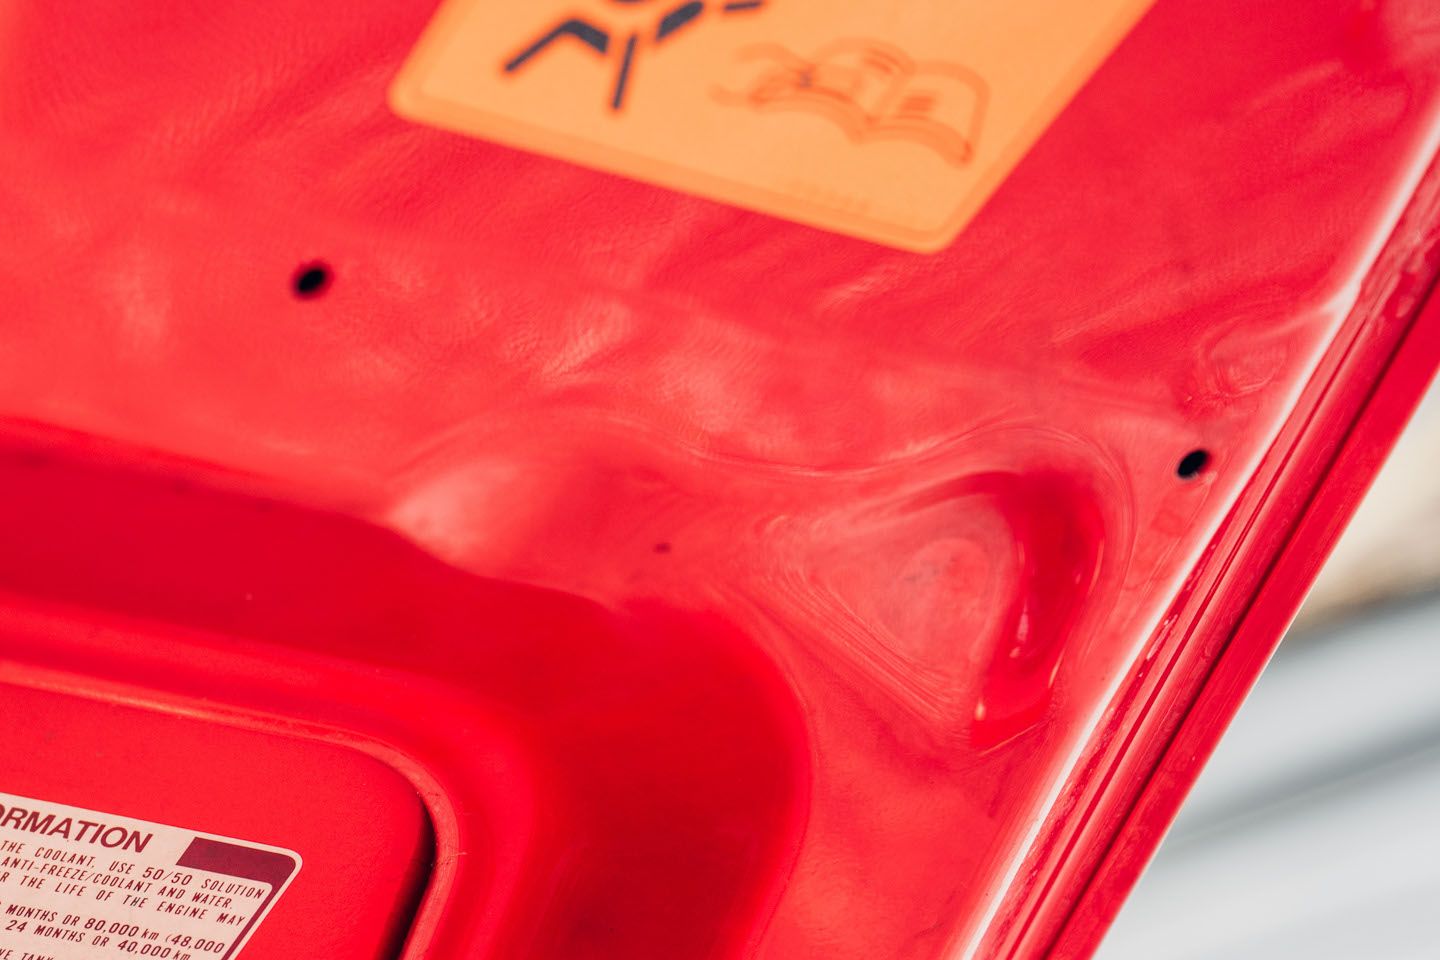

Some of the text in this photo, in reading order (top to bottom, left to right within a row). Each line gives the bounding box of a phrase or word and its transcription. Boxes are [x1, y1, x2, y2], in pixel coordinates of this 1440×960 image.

[0, 839, 25, 854] THE
[107, 859, 135, 875] USE
[141, 865, 193, 886] 50/50
[199, 877, 265, 899] SOLUTION
[19, 874, 45, 889] THE
[53, 881, 87, 897] LIFE
[94, 888, 114, 901] OF
[121, 893, 148, 908] THE
[155, 900, 208, 920] ENGINE
[215, 911, 246, 926] MAY
[156, 884, 186, 899] AND
[190, 891, 232, 910] WATER.
[4, 903, 58, 922] MONTHS
[61, 913, 81, 926] OR
[83, 917, 140, 937] 80,000
[139, 927, 160, 941] km
[164, 933, 225, 954] (48,000
[4, 918, 28, 933] 24
[32, 923, 86, 943] MONTHS
[90, 934, 110, 947] OR
[116, 939, 172, 959] 40,000
